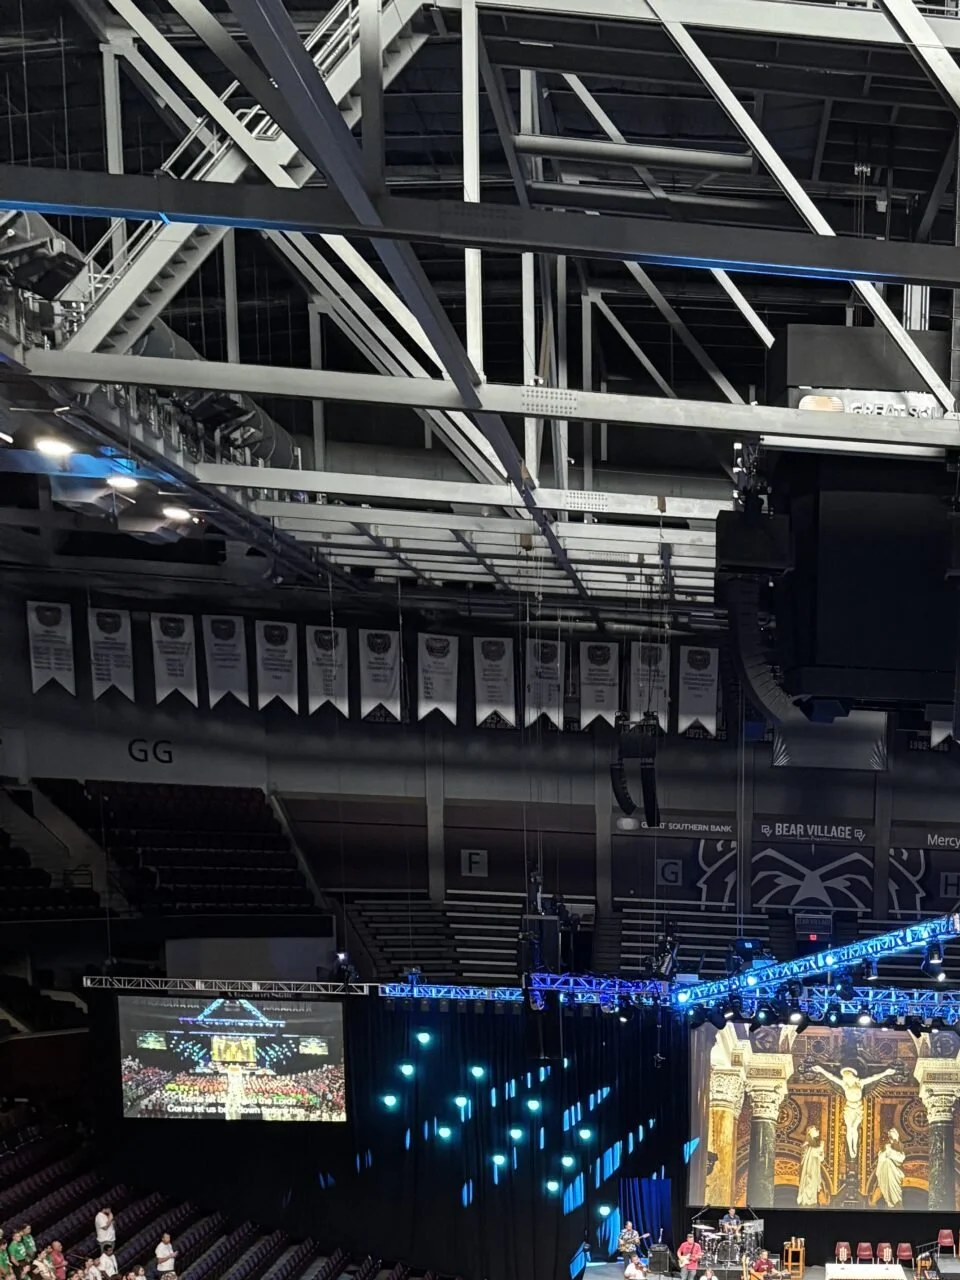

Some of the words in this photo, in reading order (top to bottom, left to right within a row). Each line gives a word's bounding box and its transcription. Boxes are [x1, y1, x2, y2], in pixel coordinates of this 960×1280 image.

[127, 738, 174, 763] GG
[668, 822, 709, 832] SOUTHERN
[710, 824, 733, 833] BANK
[775, 823, 804, 836] BEAR
[806, 824, 852, 839] VILLAGE
[468, 852, 481, 873] F
[661, 861, 679, 884] G
[944, 875, 960, 896] H
[167, 1104, 193, 1113] Come
